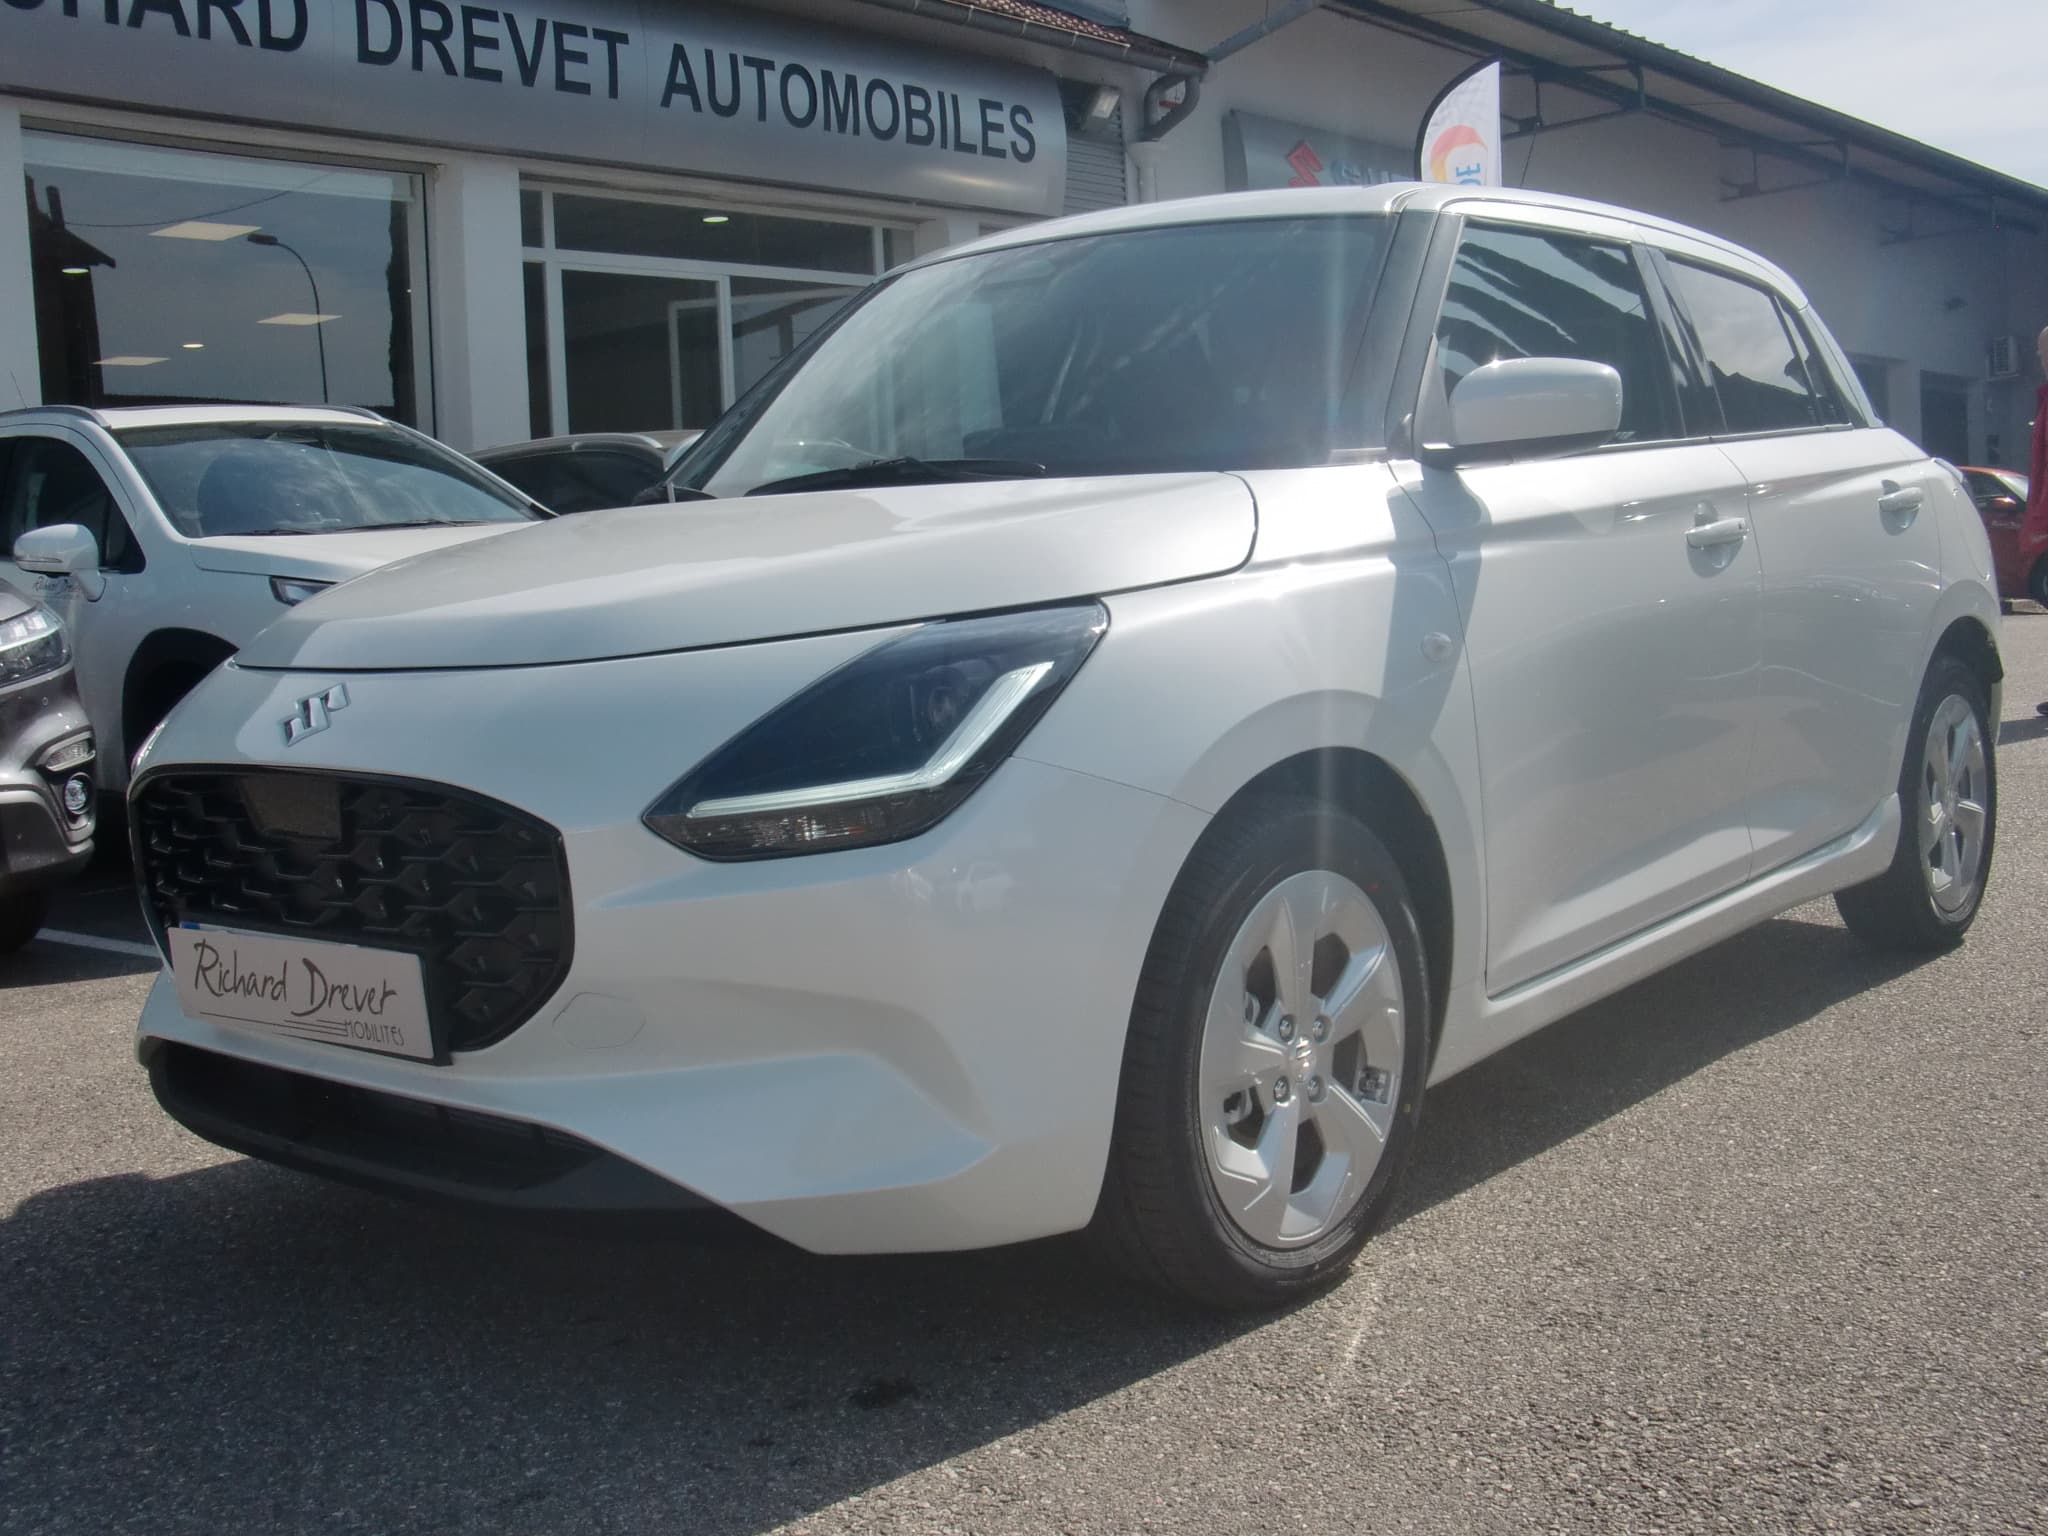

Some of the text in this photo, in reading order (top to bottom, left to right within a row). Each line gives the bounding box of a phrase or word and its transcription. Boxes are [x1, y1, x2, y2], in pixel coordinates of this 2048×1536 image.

[356, 0, 629, 100] DREVET
[660, 43, 1036, 163] AUTOMOBILES
[194, 938, 288, 1002] Richard
